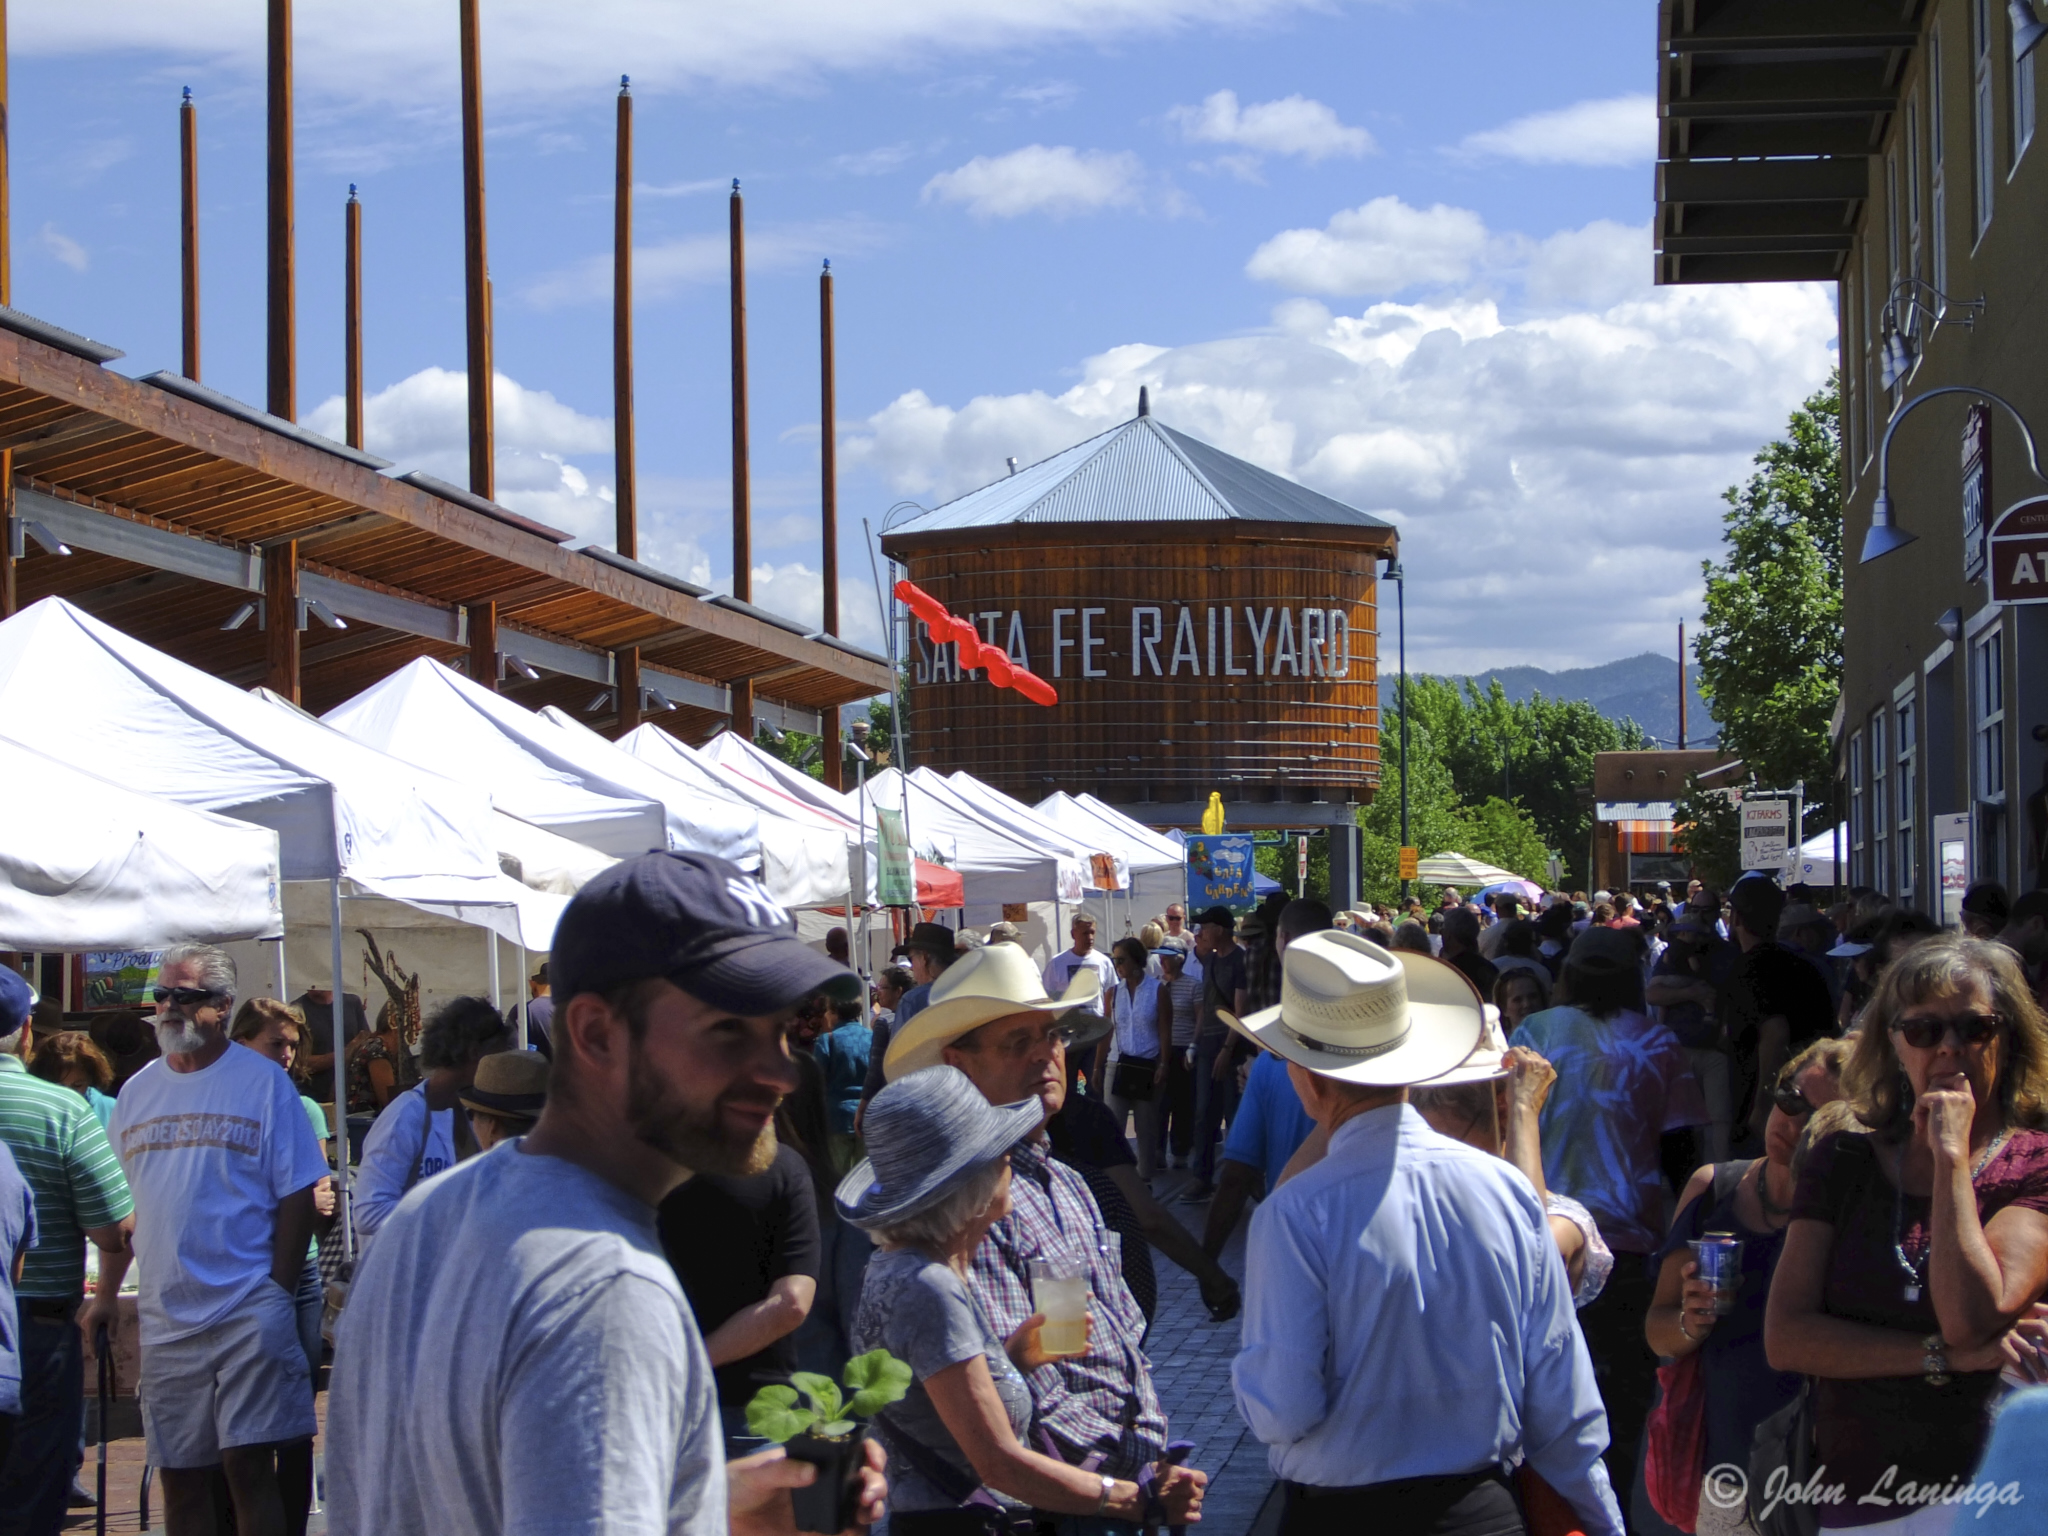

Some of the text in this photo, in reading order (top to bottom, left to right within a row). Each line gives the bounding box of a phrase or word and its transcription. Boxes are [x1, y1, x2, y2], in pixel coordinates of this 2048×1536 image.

[1053, 607, 1107, 679] FE
[1132, 606, 1348, 678] RAILYARD
[1205, 881, 1254, 900] GARDENS
